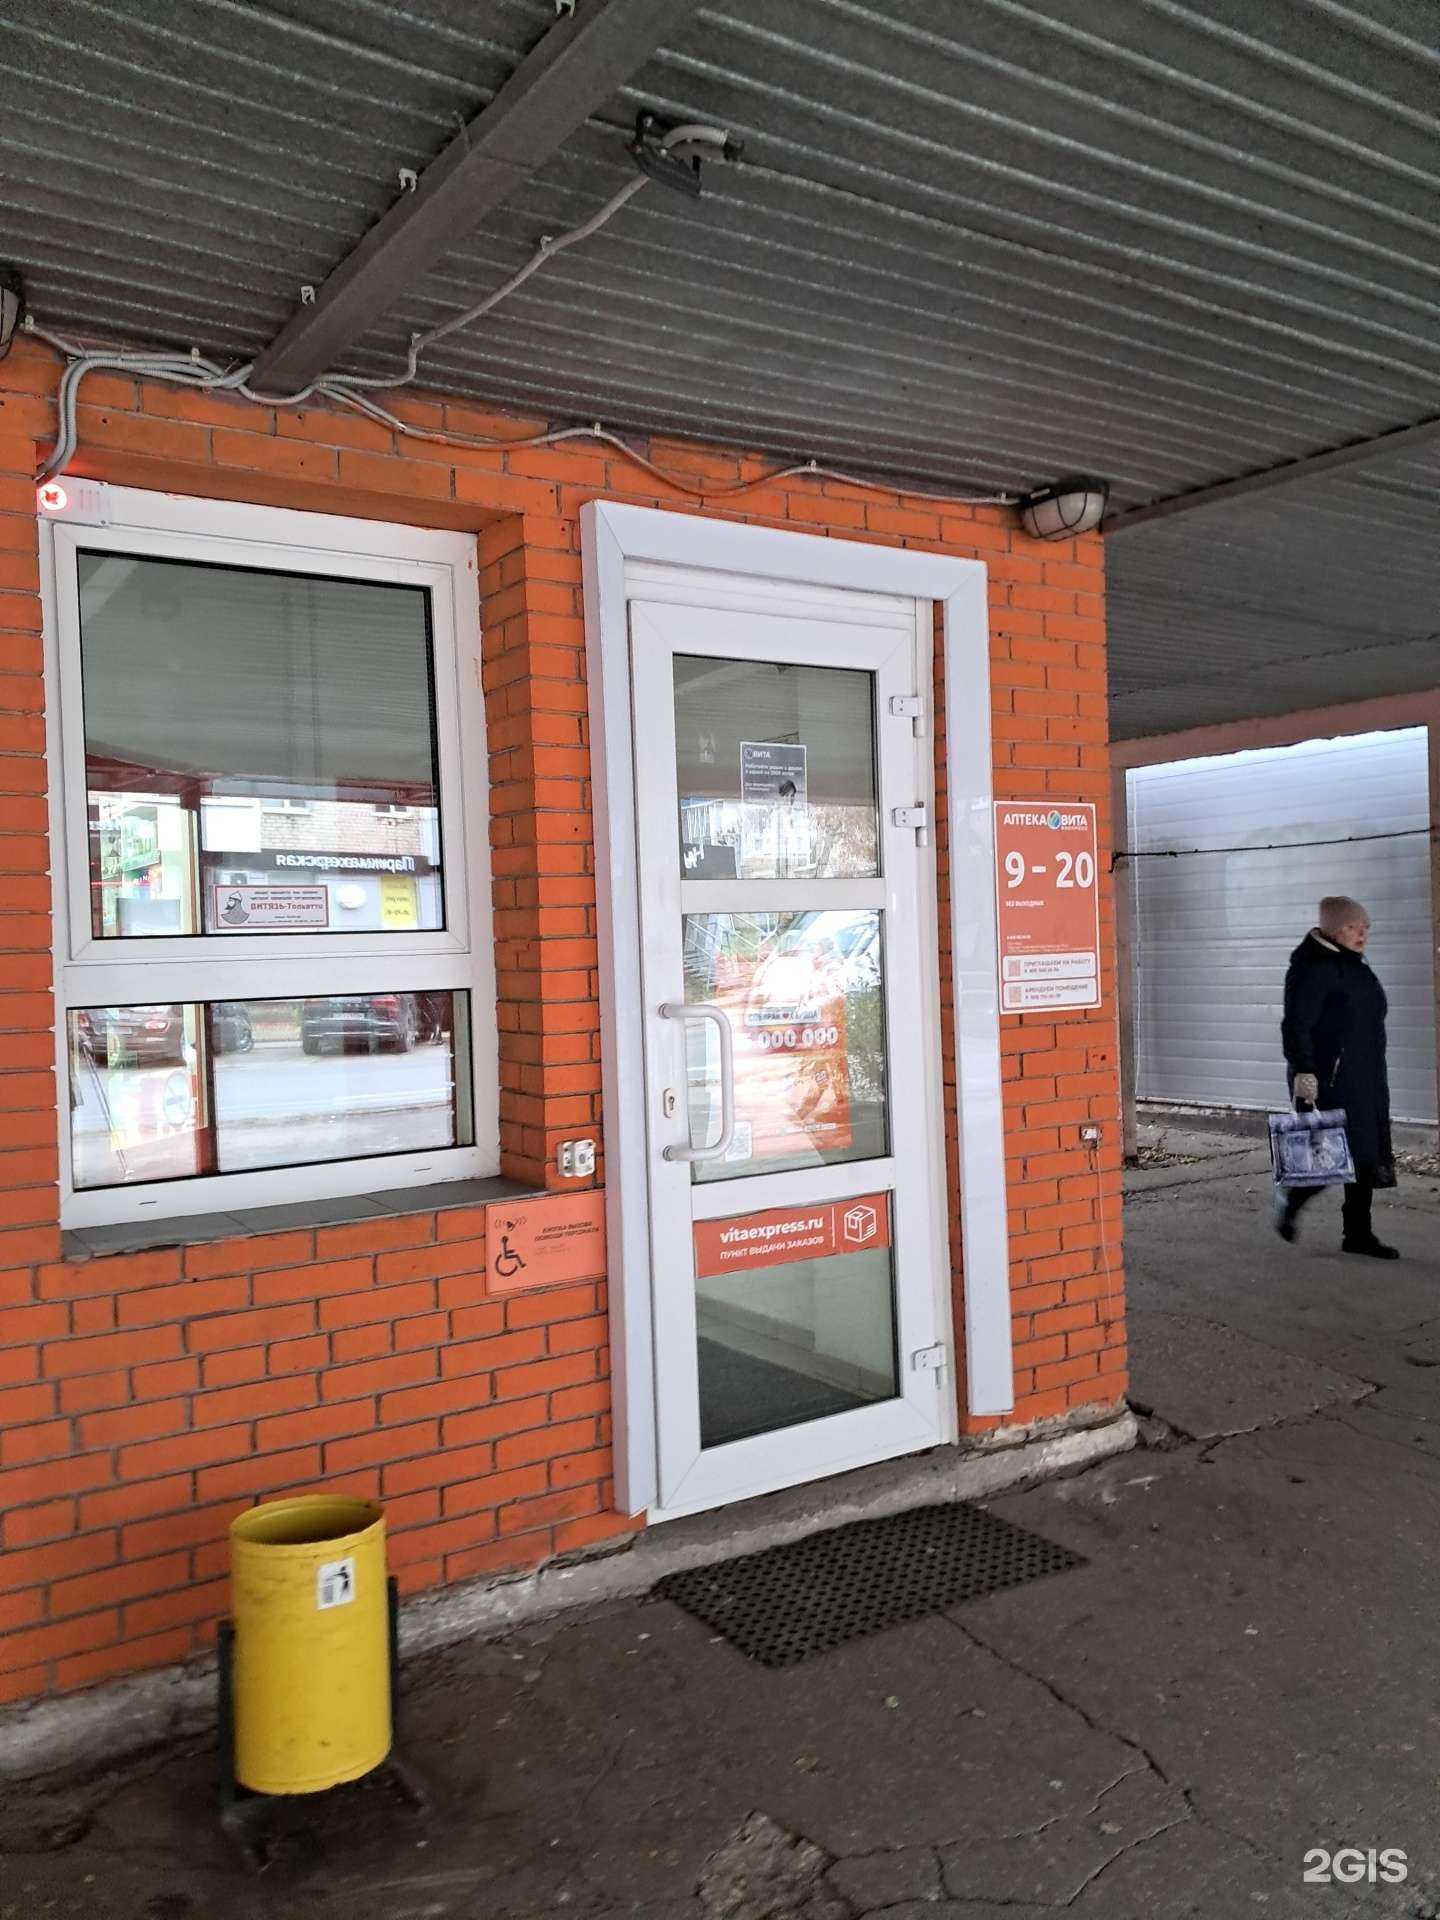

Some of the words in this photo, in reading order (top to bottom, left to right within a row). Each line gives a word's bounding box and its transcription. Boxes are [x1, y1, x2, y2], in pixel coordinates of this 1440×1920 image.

[1003, 813, 1047, 825] АПТЕКА
[1060, 814, 1088, 826] ВИТА
[1005, 851, 1025, 888] 9
[1055, 851, 1094, 888] 20
[720, 1217, 824, 1243] vitaexpress.ru
[720, 1247, 748, 1260] ПУНКТ
[748, 1243, 786, 1257] ВЫДАЧИ
[786, 1235, 825, 1250] ЗАКАЗОВ
